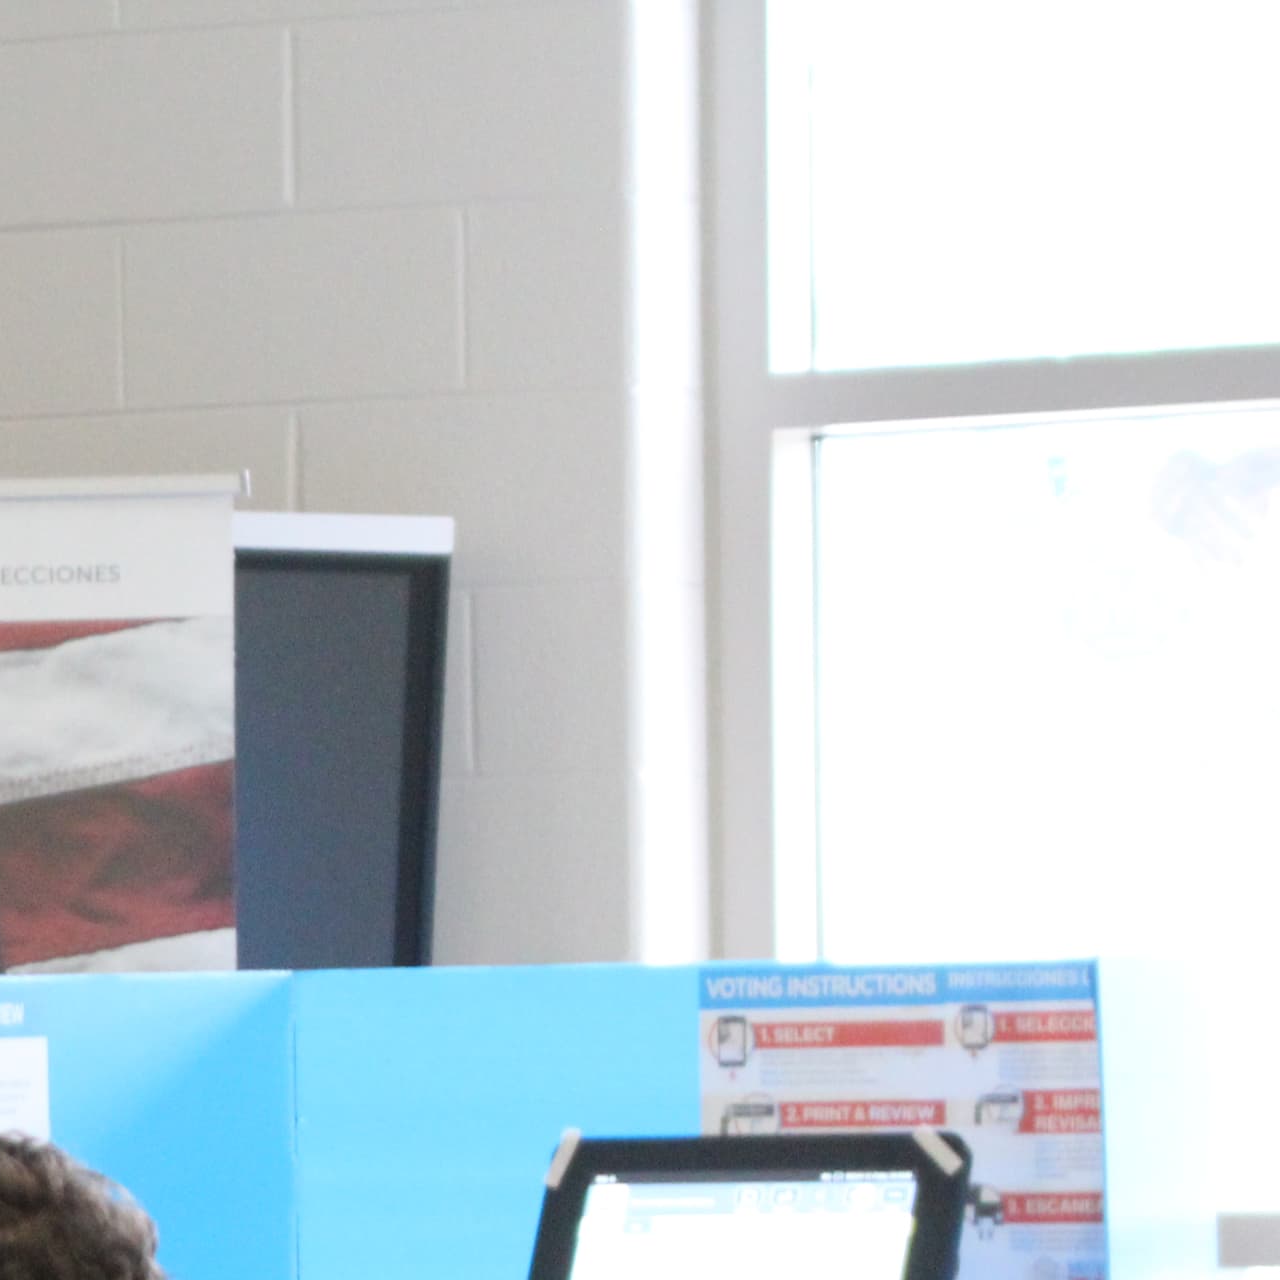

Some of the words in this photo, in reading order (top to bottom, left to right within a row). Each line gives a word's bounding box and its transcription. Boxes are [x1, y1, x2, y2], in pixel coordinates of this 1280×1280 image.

[706, 975, 784, 999] VOTING
[788, 970, 937, 997] INSTRUCTIONS
[774, 1024, 835, 1044] SELECT
[803, 1102, 851, 1123] PRINT
[869, 1099, 935, 1121] REVIEW
